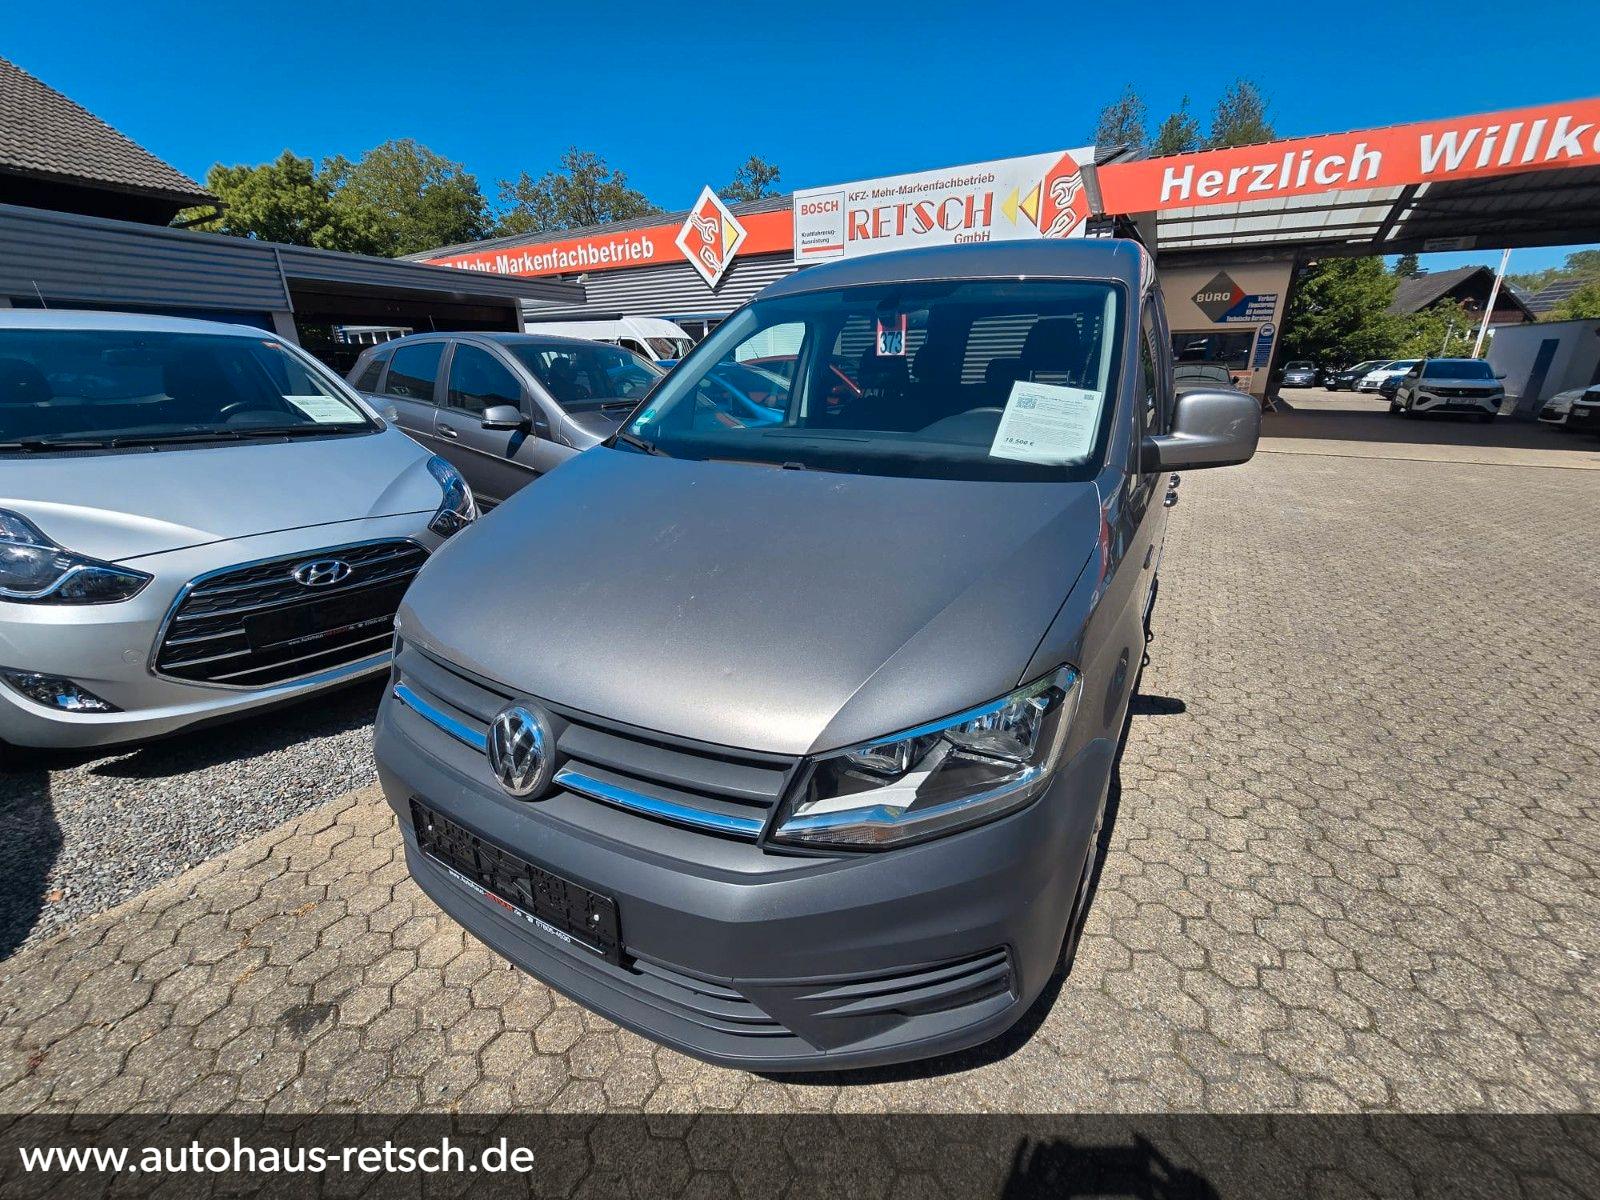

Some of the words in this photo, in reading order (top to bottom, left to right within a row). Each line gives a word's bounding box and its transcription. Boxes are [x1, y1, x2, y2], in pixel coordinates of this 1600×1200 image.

[1160, 142, 1382, 202] Herzlich
[1420, 115, 1600, 174] Willk
[872, 172, 995, 199] Mehr-Markenfachbetrieb
[801, 200, 839, 215] BOSCH
[848, 191, 994, 241] RETSCH
[954, 230, 991, 243] GmbH
[1196, 292, 1230, 302] BÜRO
[880, 331, 902, 354] 373
